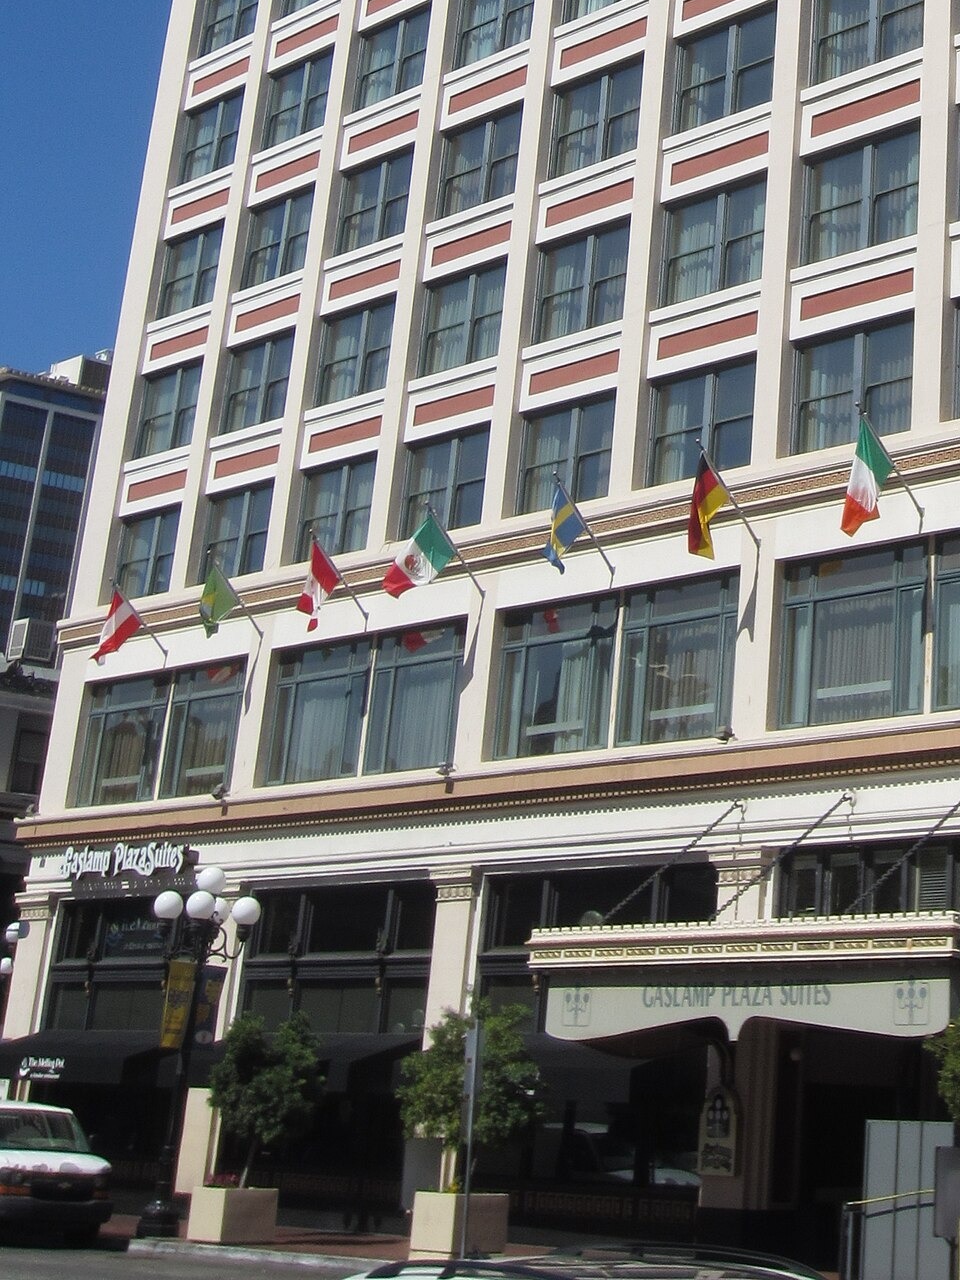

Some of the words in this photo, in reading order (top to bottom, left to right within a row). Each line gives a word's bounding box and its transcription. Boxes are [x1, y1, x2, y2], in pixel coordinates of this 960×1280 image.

[60, 846, 110, 880] Gaslamp
[114, 842, 147, 876] Plaza
[142, 841, 183, 876] Suites
[643, 983, 716, 1008] GASLAMP
[721, 981, 773, 1007] PLAZA
[779, 978, 831, 1006] SUITES
